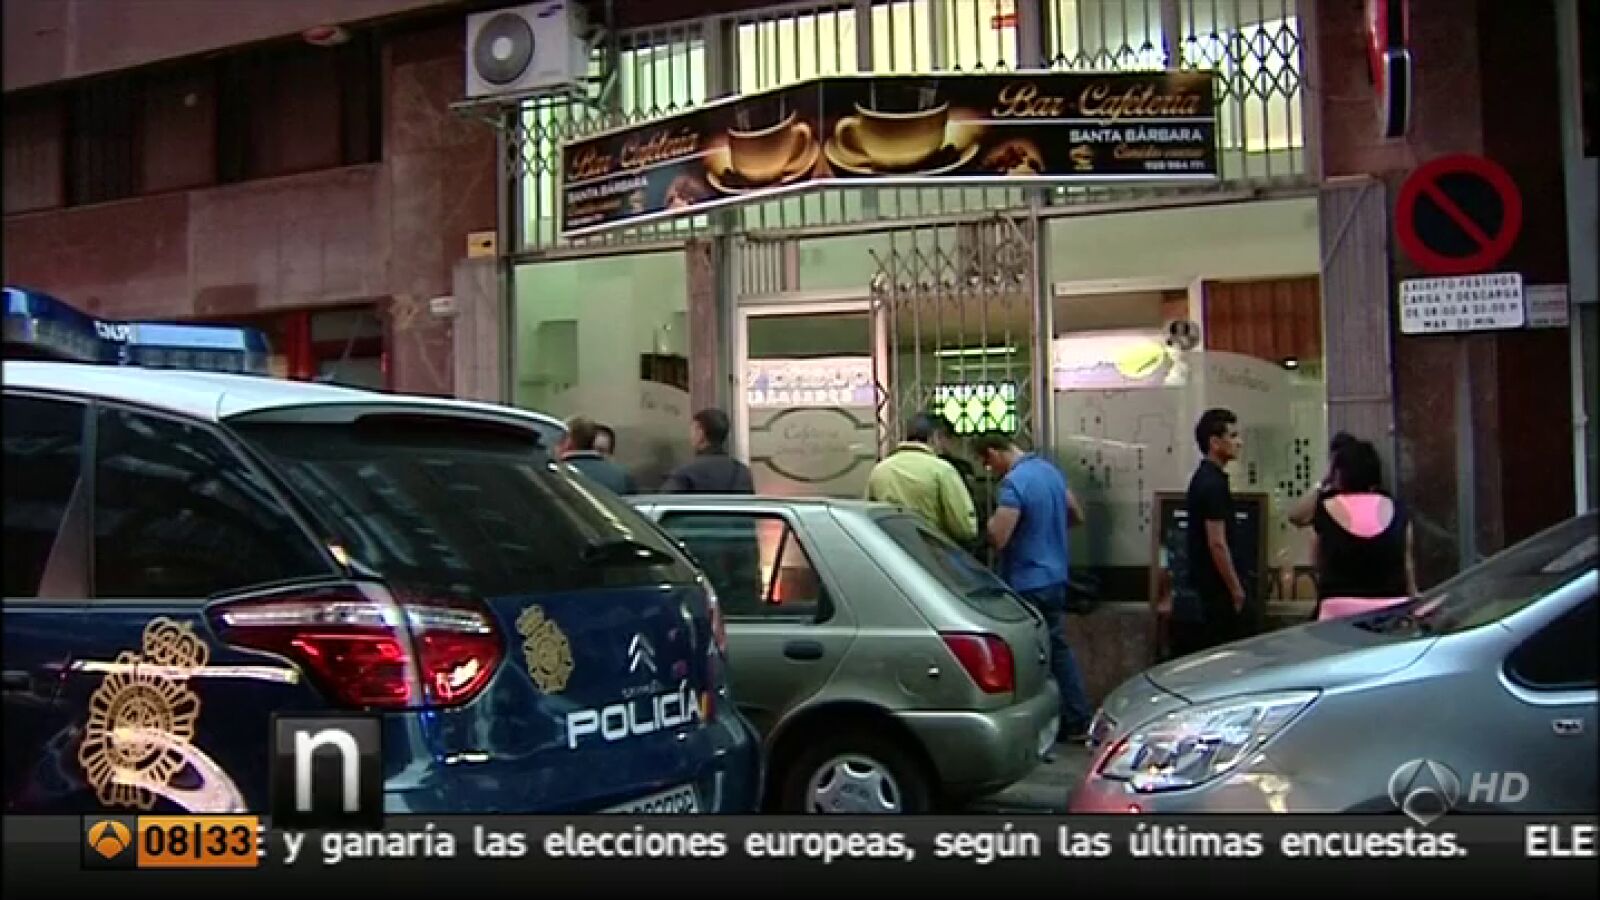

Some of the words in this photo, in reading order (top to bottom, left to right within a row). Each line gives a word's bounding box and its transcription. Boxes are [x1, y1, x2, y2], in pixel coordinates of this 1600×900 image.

[991, 83, 1064, 117] Bar
[1069, 128, 1121, 143] SANTA
[1125, 125, 1202, 143] BÁRBARA
[1404, 294, 1440, 304] CARGA
[1446, 292, 1453, 301] Y
[1456, 289, 1519, 302] DESCARGA
[567, 679, 705, 750] POLICÍA
